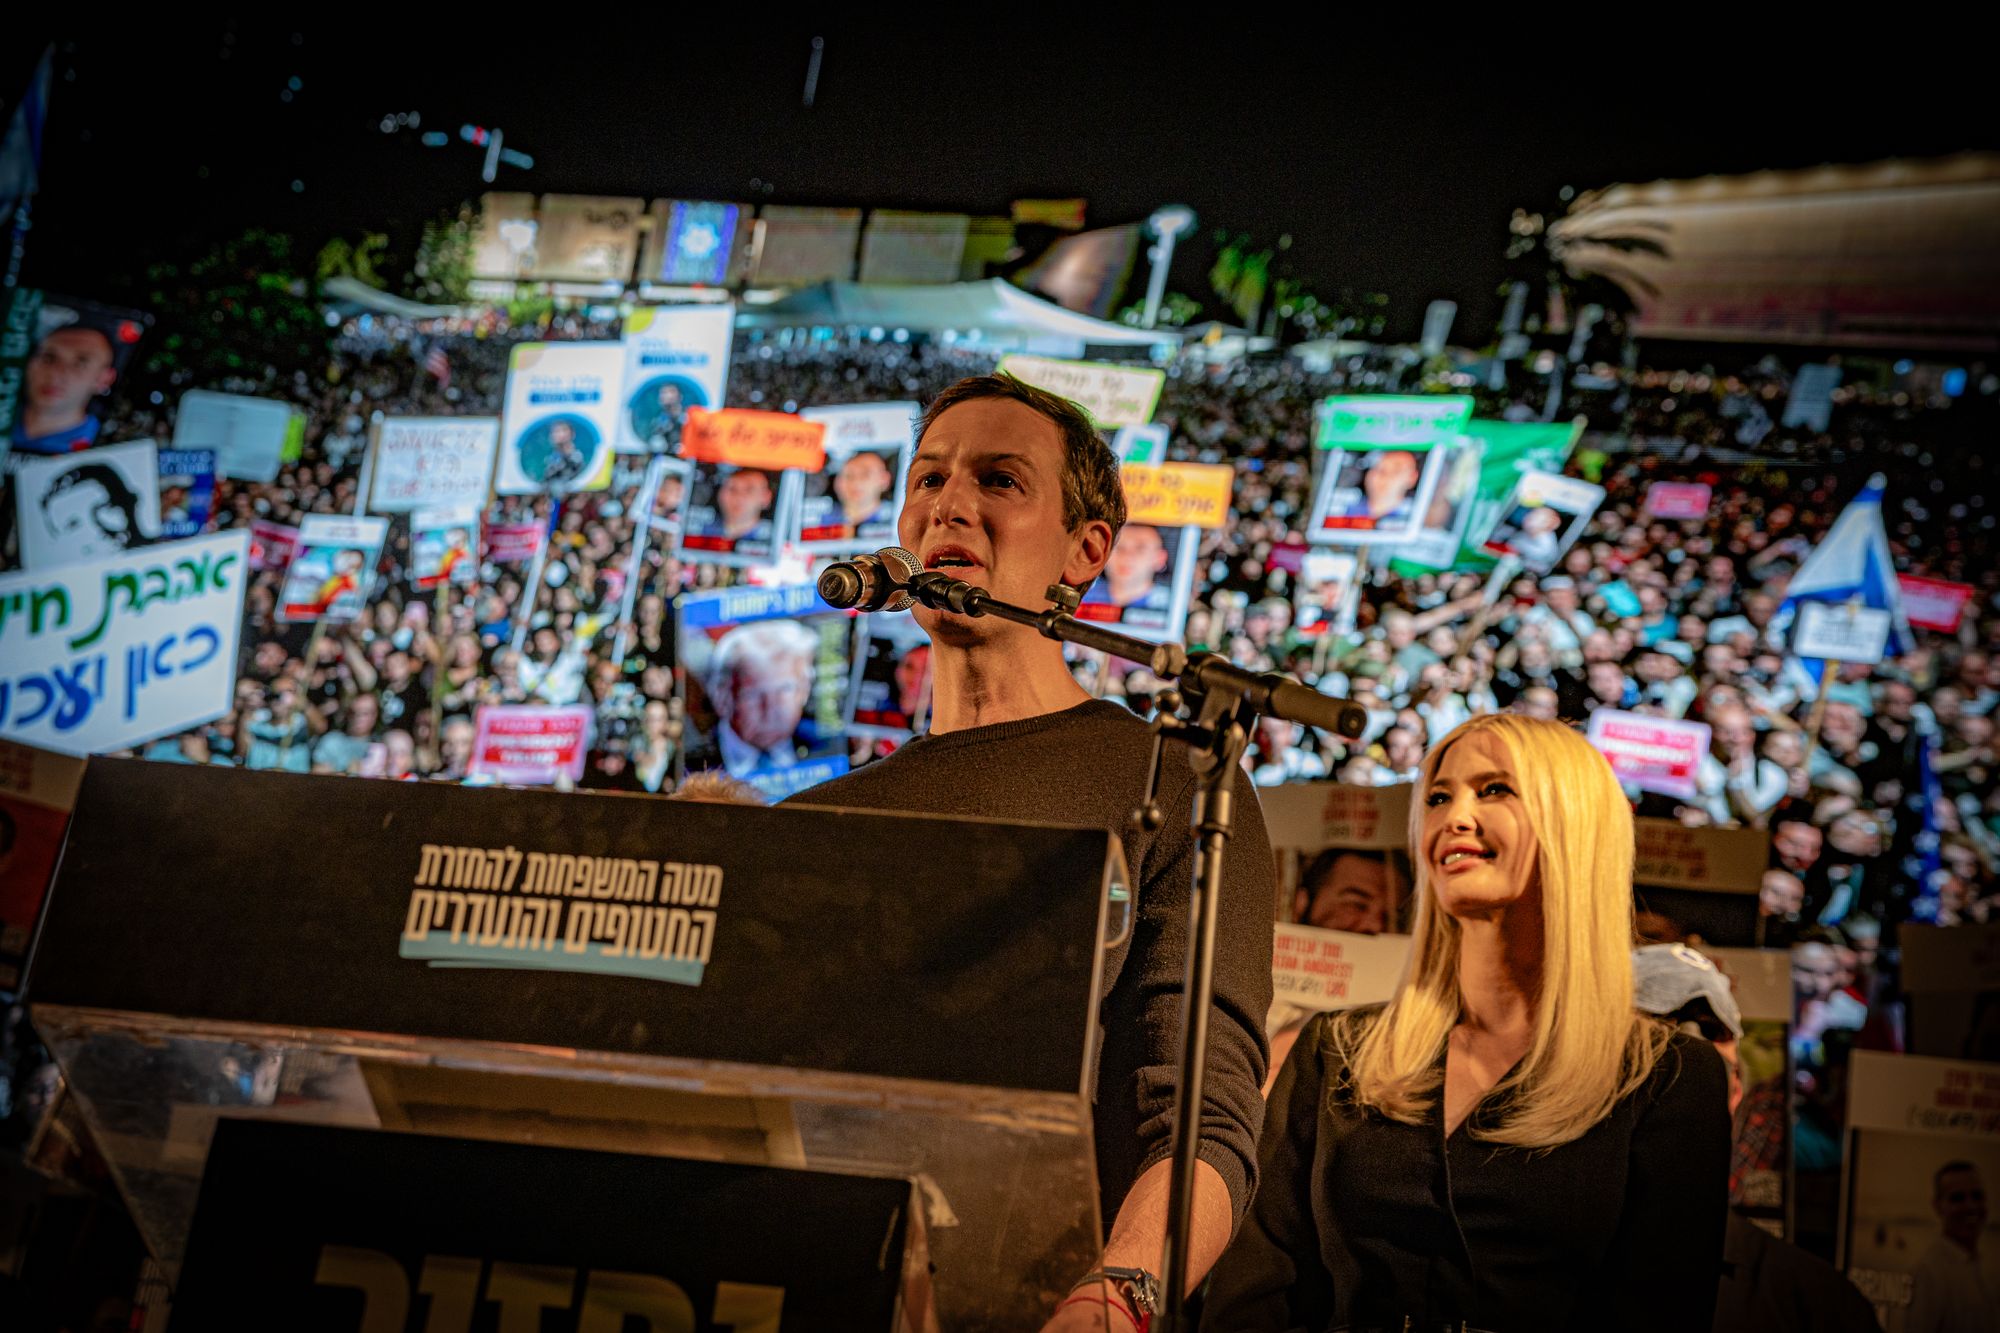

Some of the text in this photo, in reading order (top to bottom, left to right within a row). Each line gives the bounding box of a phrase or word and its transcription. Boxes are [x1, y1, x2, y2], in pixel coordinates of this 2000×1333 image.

[70, 554, 237, 649] אהבת
[414, 844, 724, 907] מטה המשפחות להחזרת
[404, 889, 717, 964] החטופים והנעדרים
